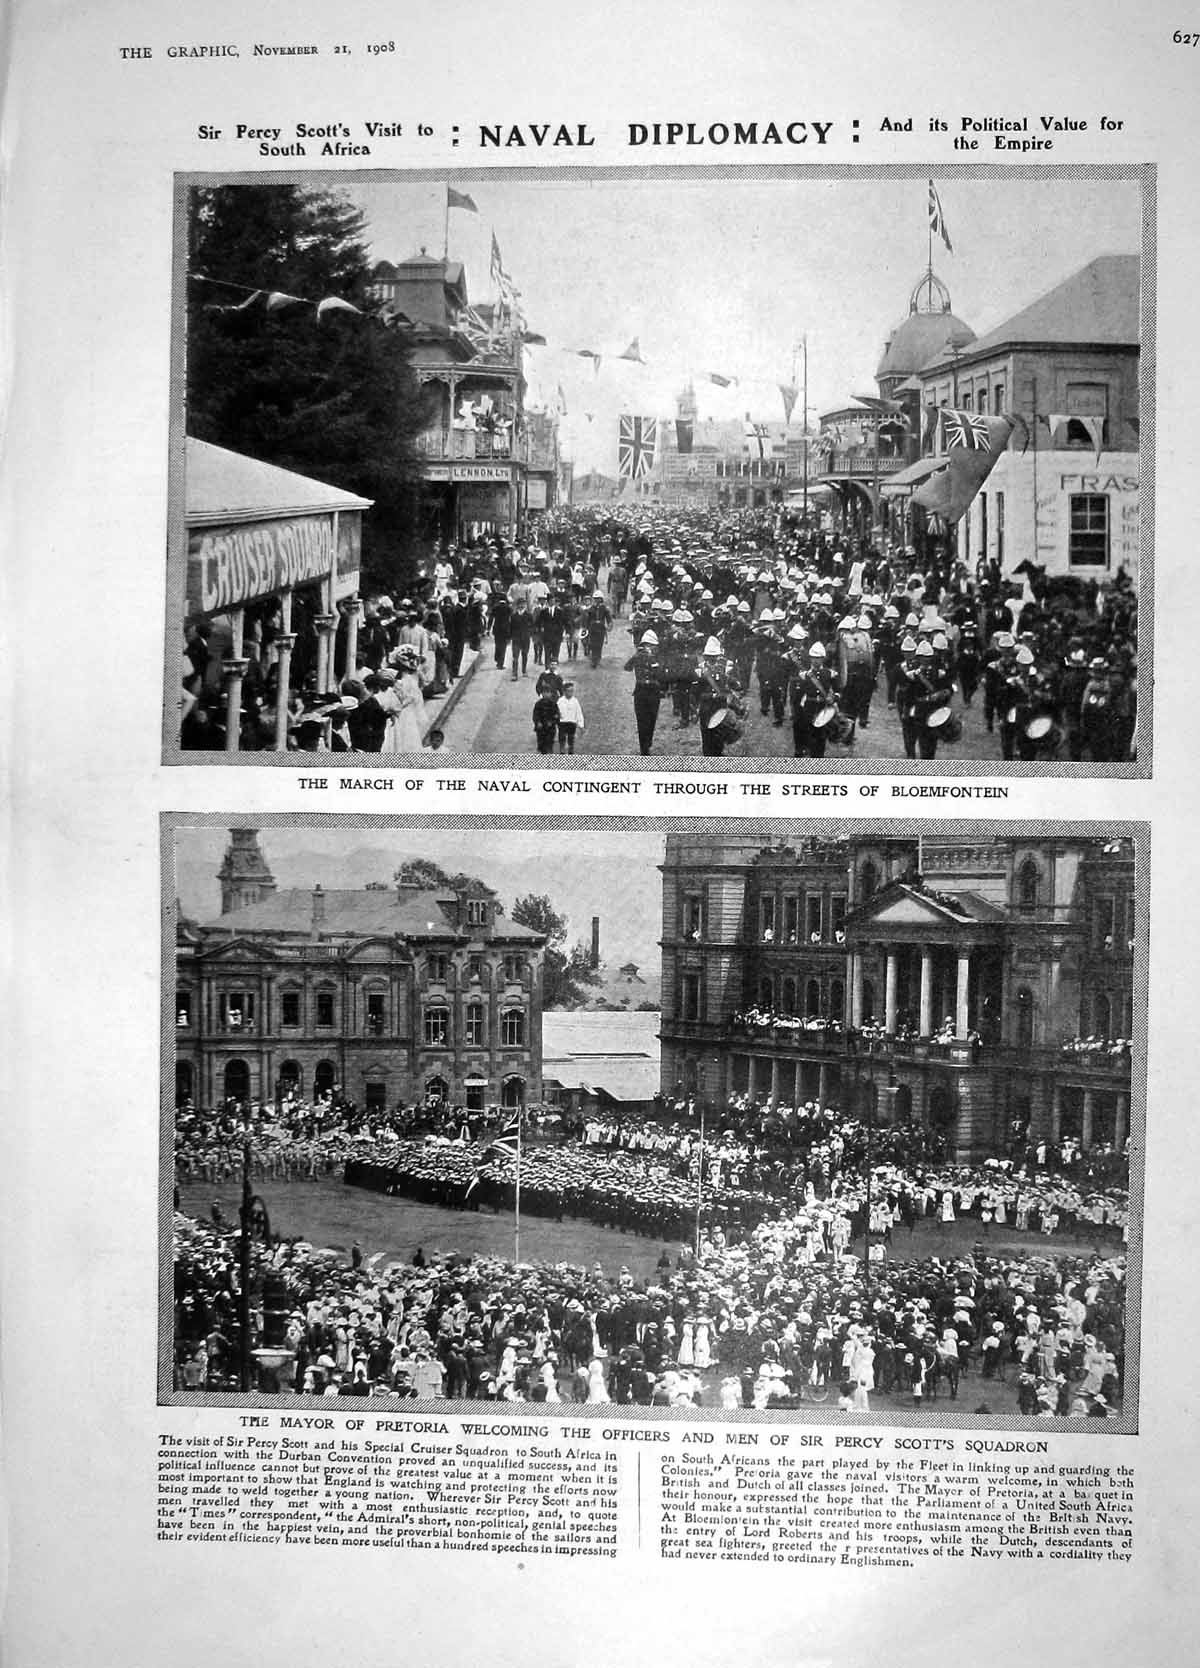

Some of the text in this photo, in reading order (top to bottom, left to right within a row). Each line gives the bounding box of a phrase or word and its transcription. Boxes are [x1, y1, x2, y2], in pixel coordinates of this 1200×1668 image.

[120, 48, 152, 59] THE
[168, 45, 239, 57] GRAPHIC,
[334, 46, 351, 54] 21,
[368, 41, 395, 55] 1908
[1173, 31, 1200, 47] 627
[198, 122, 433, 141] Sir Percy Scott's Visit to
[480, 122, 833, 147] NAVAL DIPLOMACY
[880, 117, 1123, 131] And its Political Value for
[260, 140, 370, 156] South Africa
[954, 136, 1053, 152] the Empire
[200, 529, 275, 612] CRUISER
[298, 778, 1008, 798] THE MARCH OF THE NAVAL CONTINGENT THROUGH THE STREETS OF BLOEMFONTEIN
[240, 1416, 1048, 1453] THE MAYOR OF PRETORIA WELCOMING THE OFFICERS AND MEN OF SIR PERCY SCOTT'S SQUADRON
[158, 1434, 182, 1445] The
[186, 1436, 210, 1446] visit
[213, 1436, 224, 1446] of
[226, 1436, 244, 1447] Sir
[247, 1437, 278, 1450] Percy
[281, 1438, 308, 1449] Scott
[314, 1439, 335, 1450] and
[341, 1440, 358, 1451] his
[364, 1441, 404, 1455] Special
[410, 1443, 453, 1454] Cruiser
[455, 1444, 508, 1458] Squadron
[516, 1447, 527, 1457] to
[530, 1447, 562, 1458] South
[605, 1451, 617, 1460] in
[157, 1447, 217, 1458] connection
[224, 1448, 250, 1459] with
[256, 1449, 273, 1460] the
[279, 1450, 321, 1461] Durban
[327, 1452, 392, 1464] Convention
[399, 1454, 436, 1468] proved
[462, 1456, 524, 1471] unqualified
[528, 1462, 572, 1471] success,
[575, 1460, 596, 1471] and
[604, 1462, 618, 1472] its
[661, 1455, 675, 1463] on
[682, 1453, 714, 1464] South
[778, 1456, 795, 1466] the
[802, 1458, 824, 1469] part
[832, 1457, 868, 1471] played
[876, 1459, 890, 1471] by
[896, 1459, 914, 1470] the
[920, 1460, 948, 1471] Fleet
[952, 1462, 964, 1472] in
[968, 1462, 1010, 1475] linking
[1014, 1466, 1029, 1476] up
[1033, 1464, 1055, 1474] and
[1058, 1464, 1111, 1478] guarding
[1116, 1466, 1134, 1477] the
[158, 1471, 617, 1496] most important to show that England is watching and protecting the efforts now
[158, 1481, 188, 1495] being
[192, 1483, 222, 1494] made
[227, 1485, 239, 1494] to
[242, 1484, 268, 1495] weld
[274, 1485, 319, 1499] together
[335, 1491, 369, 1501] young
[375, 1490, 414, 1500] nation.
[426, 1491, 481, 1503] Wherever
[484, 1493, 502, 1503] Sir
[507, 1494, 539, 1507] Percy
[542, 1495, 569, 1506] Scott
[575, 1496, 596, 1507] and
[600, 1497, 618, 1507] his
[662, 1488, 689, 1499] their
[693, 1489, 737, 1502] honour,
[743, 1491, 798, 1505] expressed
[802, 1493, 819, 1503] the
[827, 1493, 853, 1506] hope
[861, 1494, 883, 1505] that
[891, 1495, 908, 1506] the
[916, 1496, 981, 1508] Parliament
[984, 1498, 995, 1508] of
[1016, 1499, 1055, 1510] United
[1058, 1500, 1092, 1511] South
[157, 1529, 183, 1540] their
[186, 1530, 227, 1541] evident
[228, 1531, 281, 1545] efficiency
[285, 1533, 311, 1544] have
[314, 1534, 339, 1545] been
[372, 1536, 404, 1547] useful
[406, 1538, 432, 1548] than
[443, 1539, 489, 1550] hundred
[491, 1541, 539, 1554] speeches
[541, 1544, 552, 1553] in
[555, 1544, 617, 1557] impressing
[661, 1548, 914, 1568] had never extended to ordinary Englishmen.
